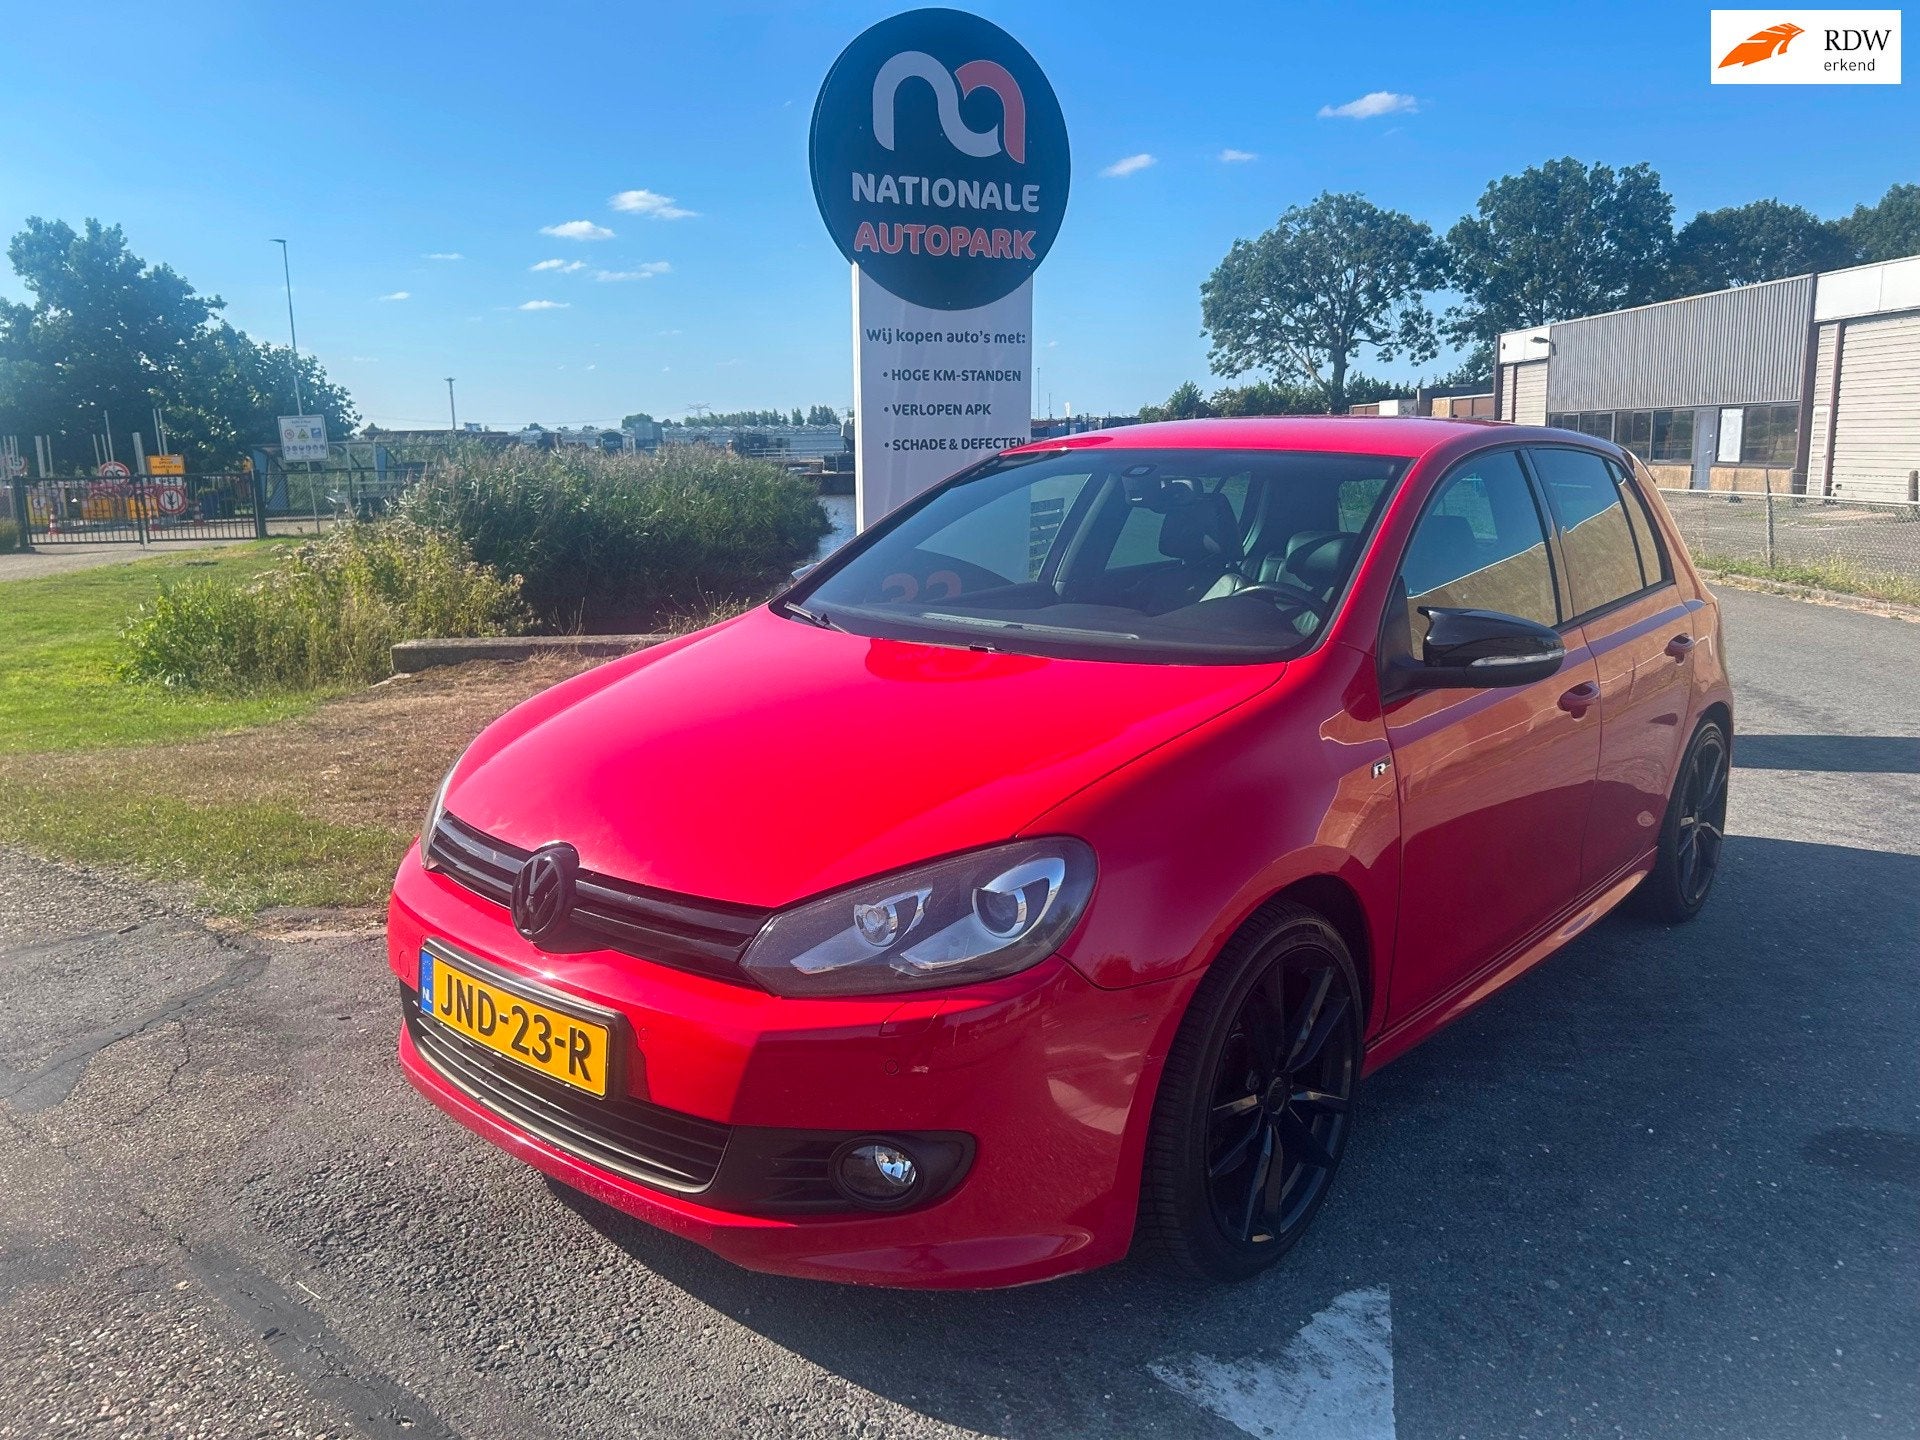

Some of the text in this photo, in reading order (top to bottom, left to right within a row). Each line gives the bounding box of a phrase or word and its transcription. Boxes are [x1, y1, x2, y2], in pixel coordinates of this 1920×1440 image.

[851, 171, 1040, 213] NATIONALE
[853, 221, 1036, 260] AUTOPARK
[866, 328, 1026, 345] Wij kopen auto's met:
[891, 369, 1022, 382] HOGE KM-STANDEN
[892, 404, 992, 416] VERLOPEN APK
[892, 437, 1026, 451] SCHADE & DEFECTEN
[440, 973, 592, 1082] JND-23-R
